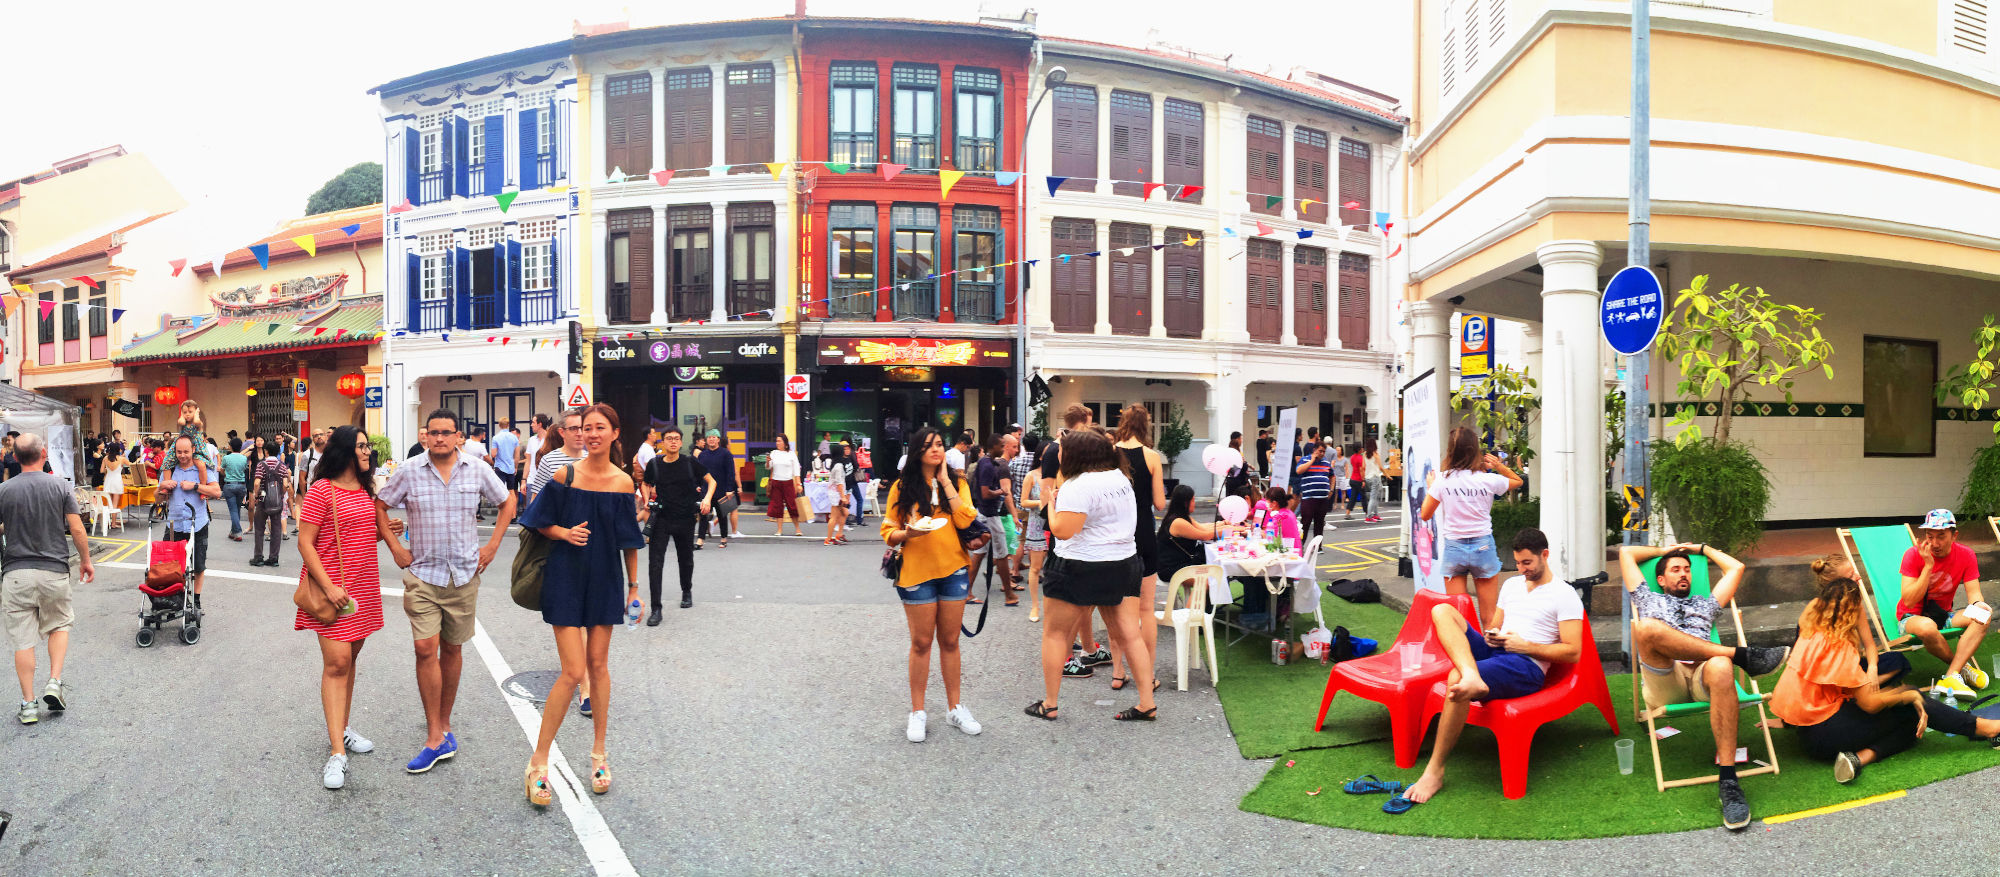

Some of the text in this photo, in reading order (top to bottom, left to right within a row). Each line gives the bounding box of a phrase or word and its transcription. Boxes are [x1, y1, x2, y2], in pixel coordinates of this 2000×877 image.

[1606, 292, 1656, 310] SHARE THE ROAD
[1468, 320, 1484, 342] P
[599, 347, 627, 361] draft
[738, 343, 769, 357] draft
